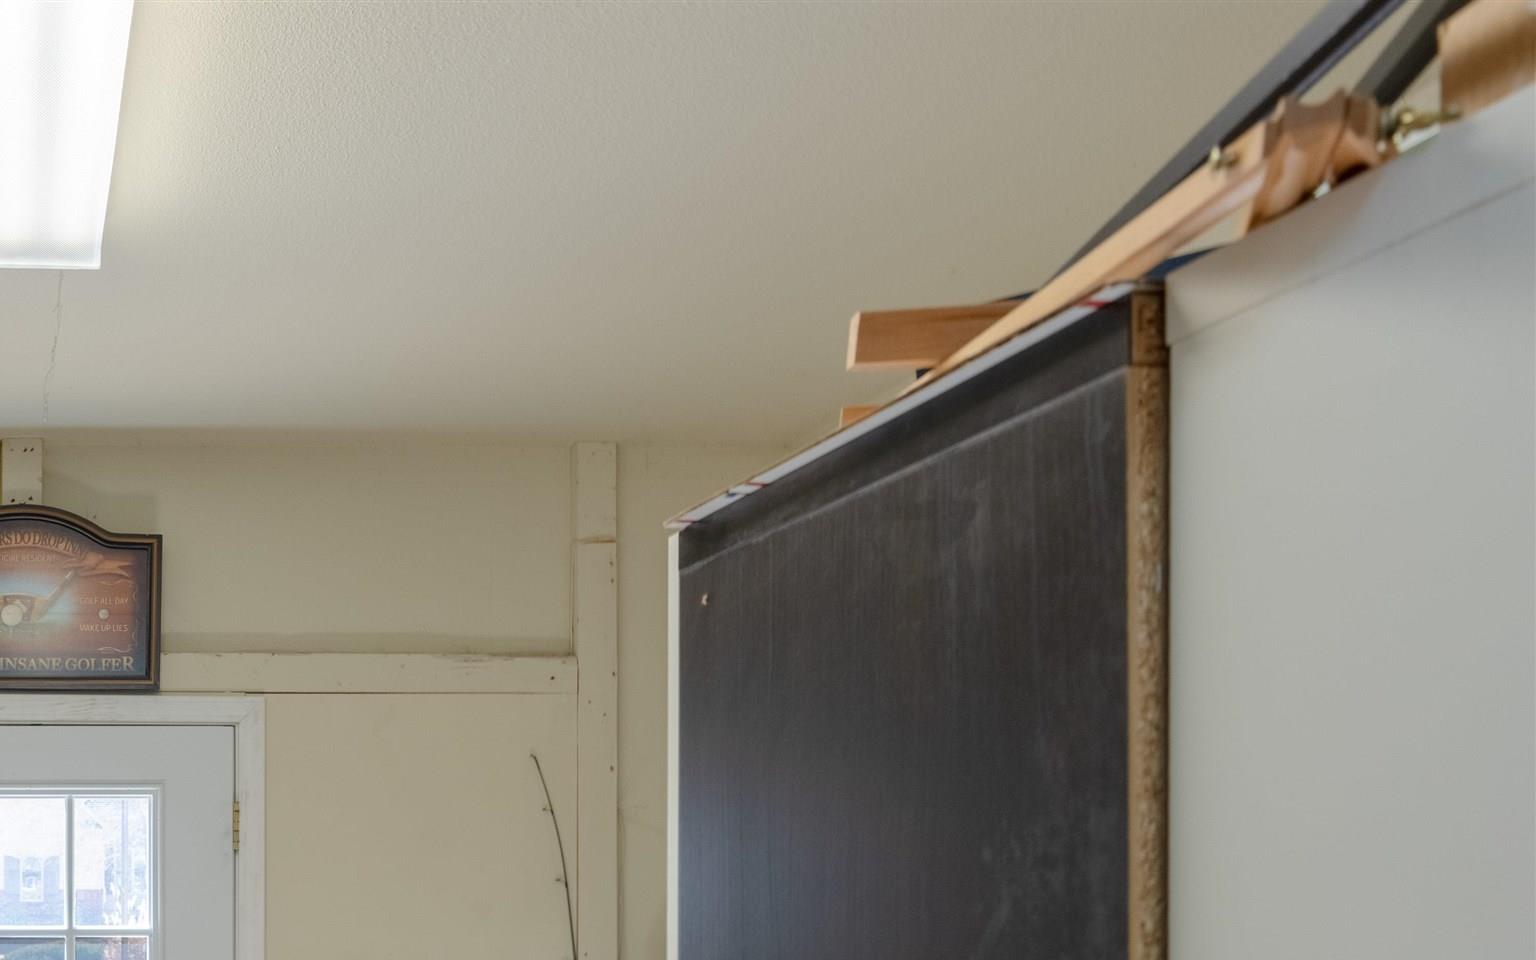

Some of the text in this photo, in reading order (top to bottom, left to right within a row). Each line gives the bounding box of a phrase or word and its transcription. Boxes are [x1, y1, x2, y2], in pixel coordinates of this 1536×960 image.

[14, 531, 32, 546] DO
[112, 623, 129, 633] LIES
[0, 656, 62, 673] INSANE
[64, 655, 135, 674] GOLFER
